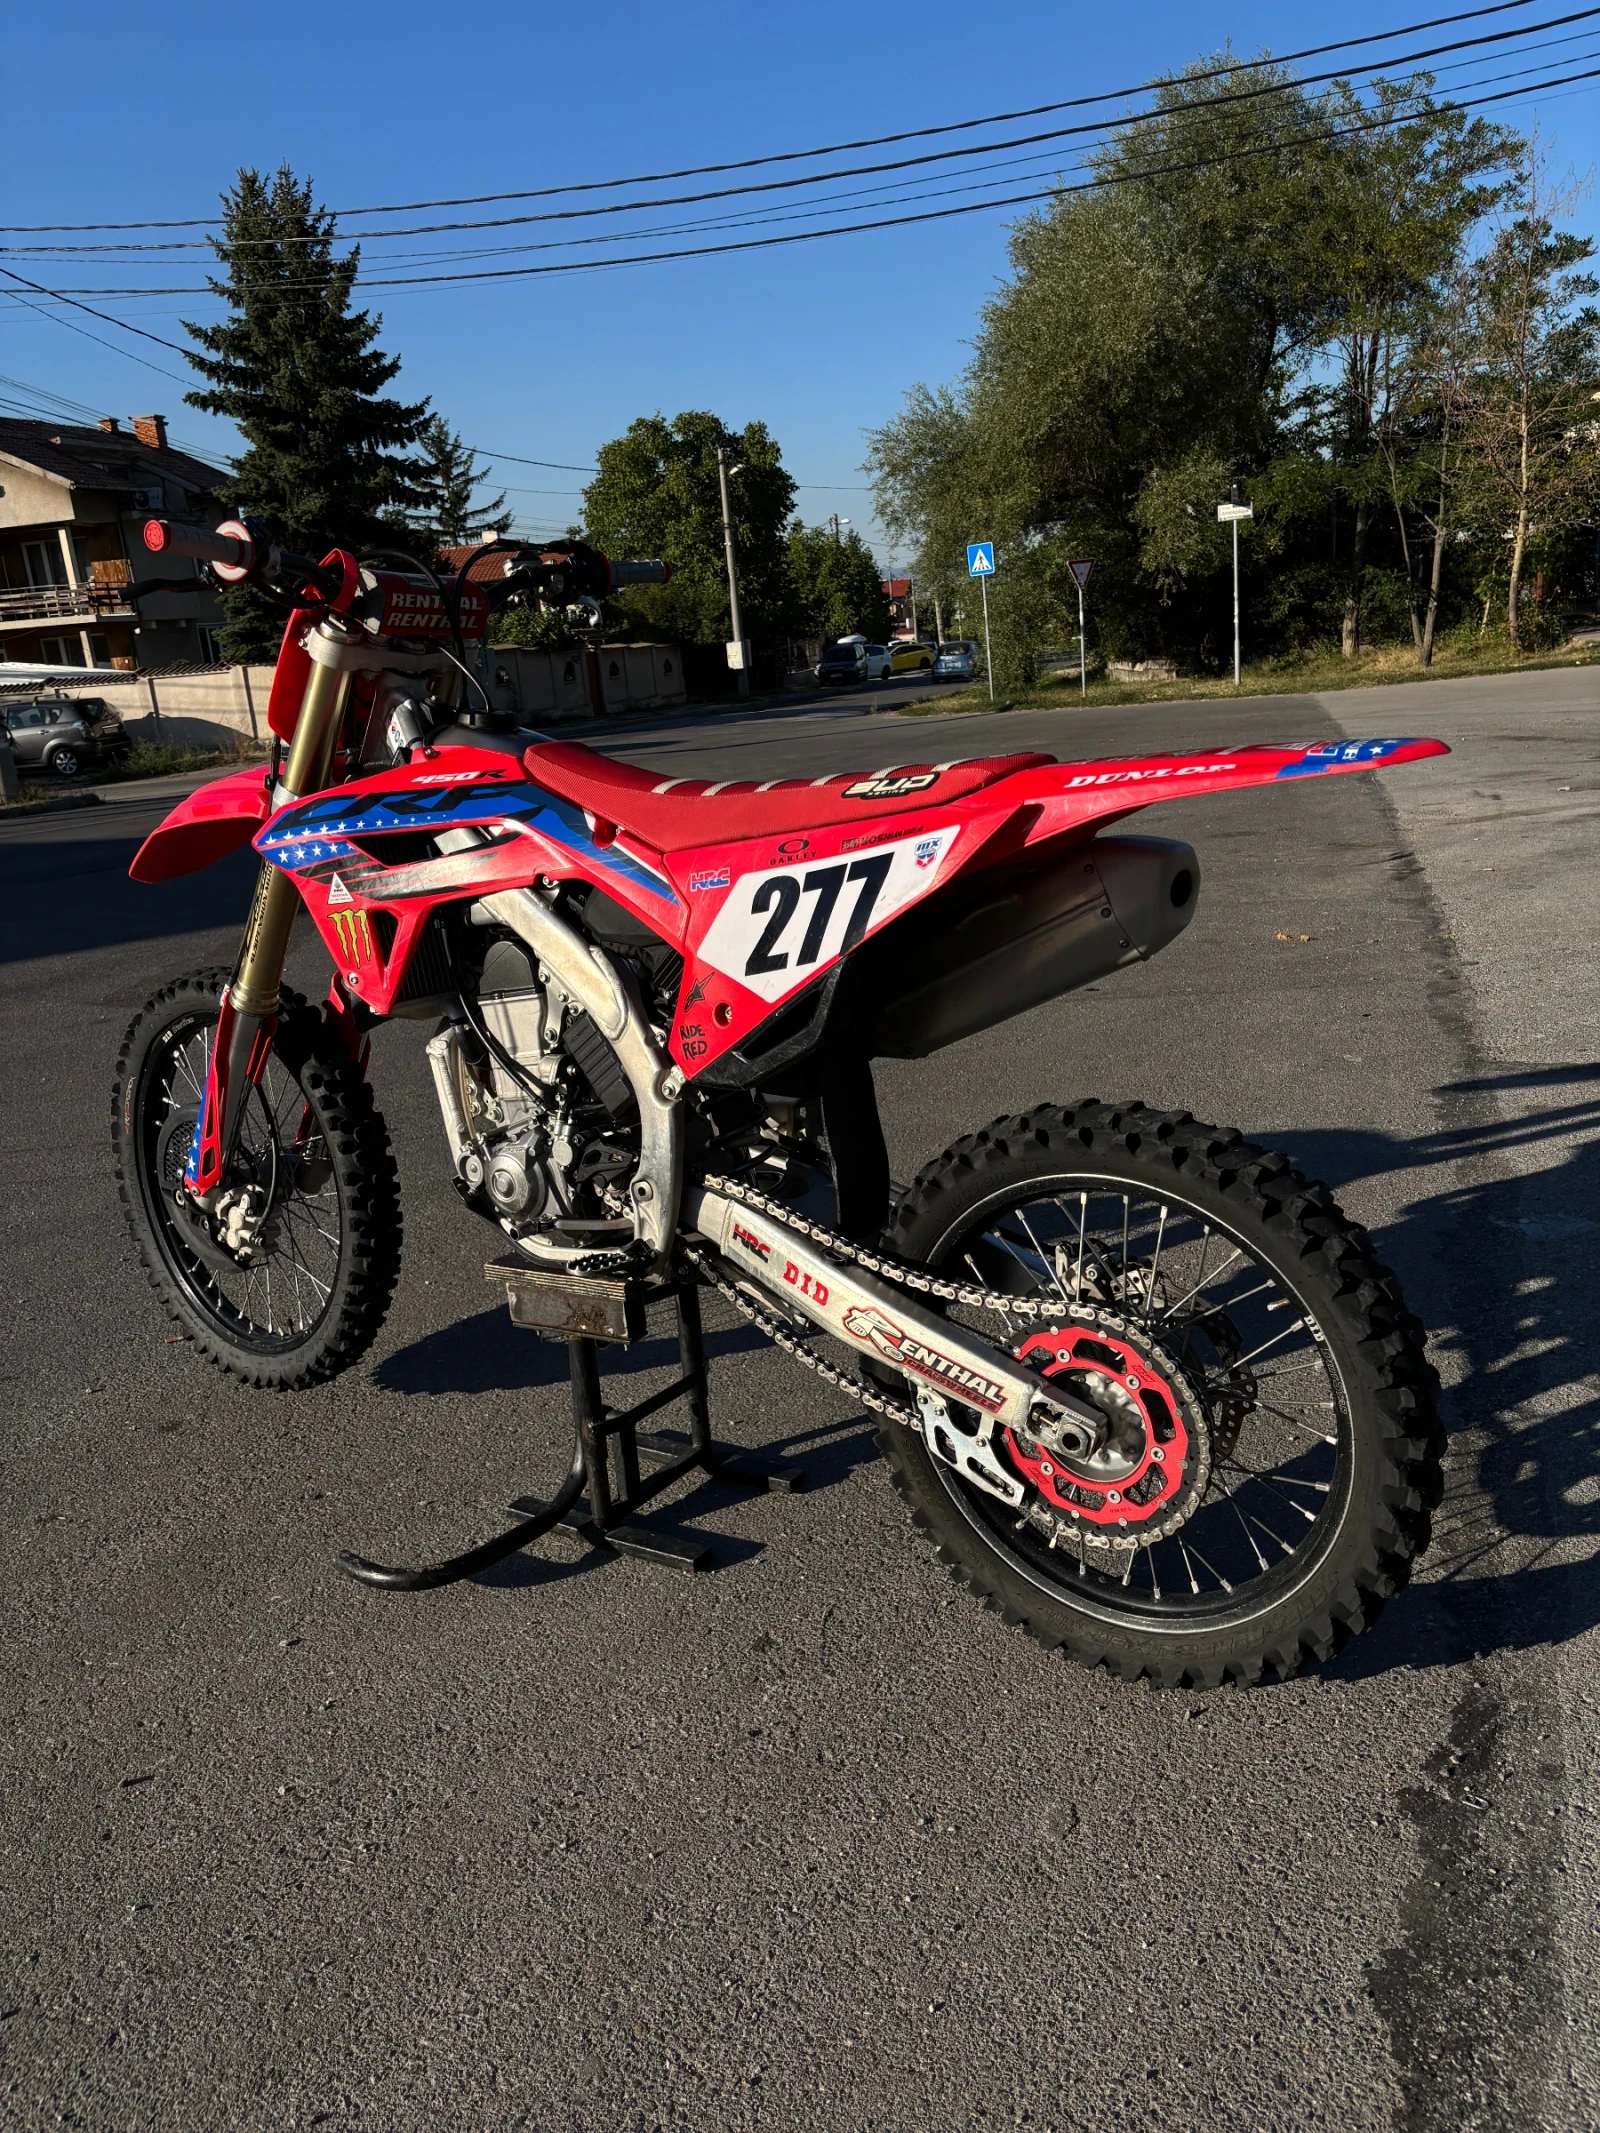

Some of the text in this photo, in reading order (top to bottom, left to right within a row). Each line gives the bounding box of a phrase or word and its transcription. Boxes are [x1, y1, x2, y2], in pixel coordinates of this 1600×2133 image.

[390, 592, 483, 611] RENTAL
[410, 768, 508, 785] 450R
[845, 773, 935, 795] BUD
[1063, 763, 1237, 789] DUNLOP
[269, 780, 528, 834] CRF
[861, 825, 924, 848] YOSHIMURA
[769, 850, 817, 866] OAKLEY
[690, 867, 730, 892] HRC
[745, 851, 895, 977] 277
[679, 1024, 705, 1040] RIDE
[681, 1040, 708, 1061] RED
[732, 1223, 771, 1264] HRC
[907, 1358, 999, 1411] CHAINWHEELS
